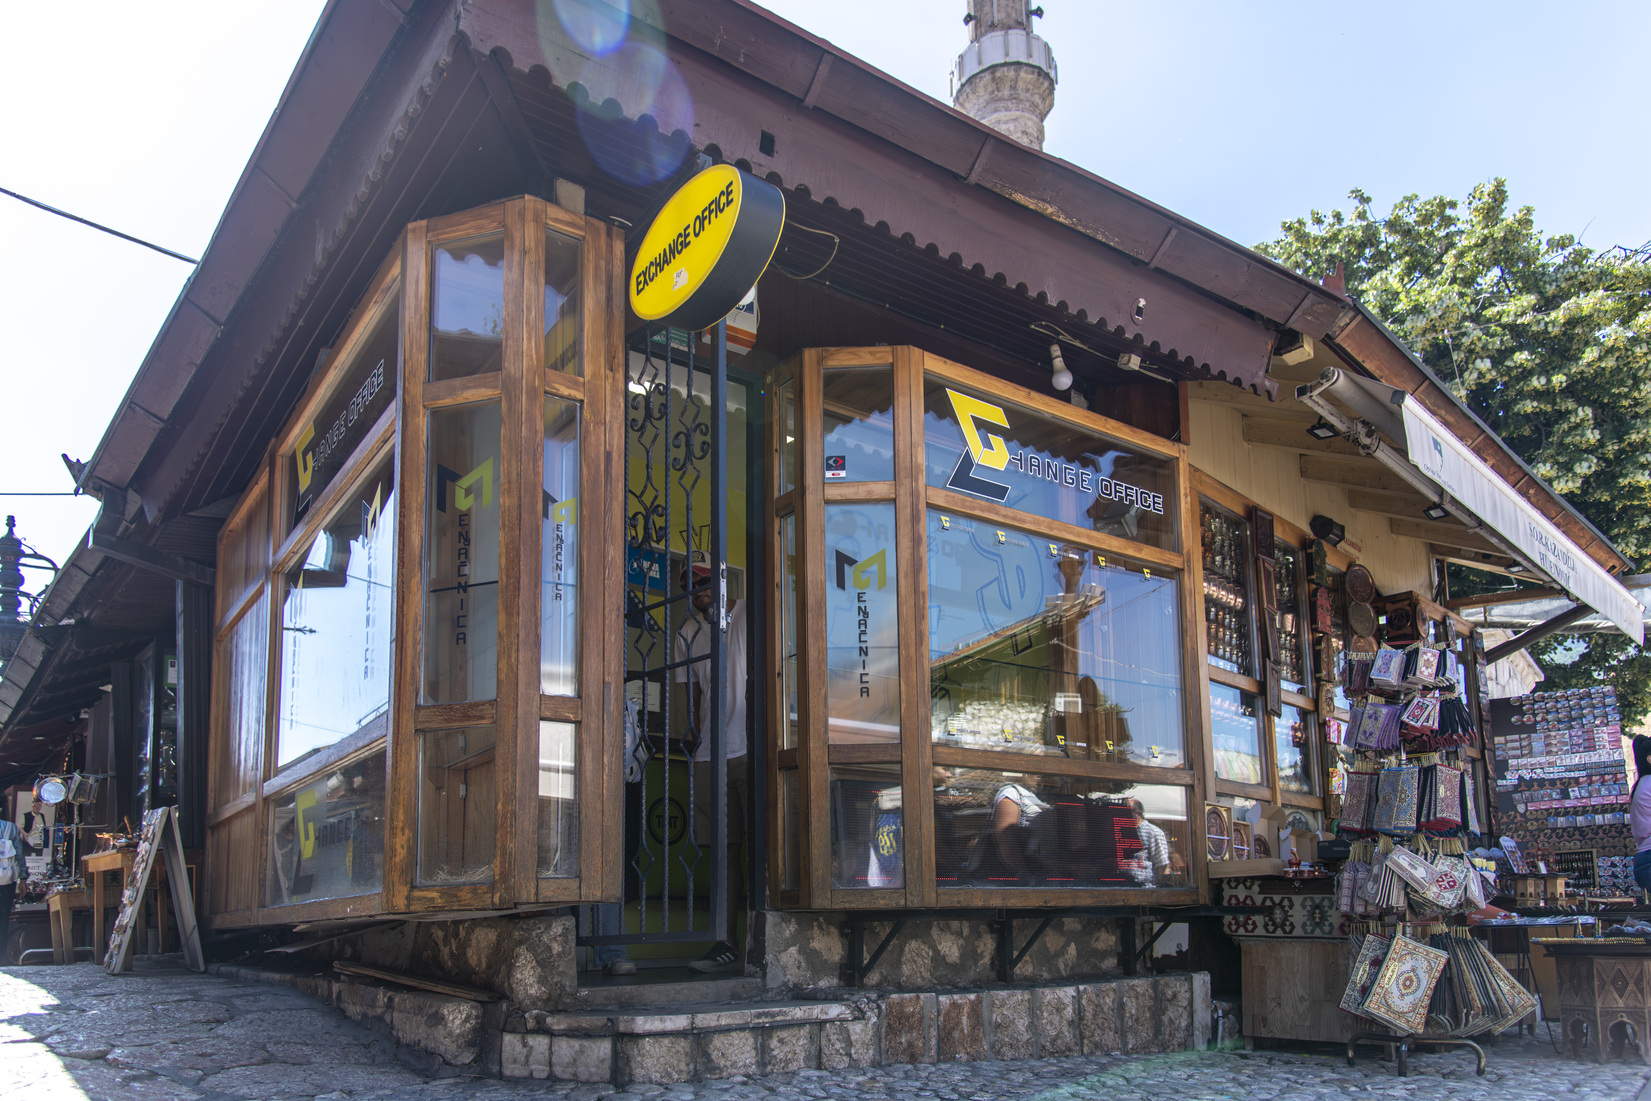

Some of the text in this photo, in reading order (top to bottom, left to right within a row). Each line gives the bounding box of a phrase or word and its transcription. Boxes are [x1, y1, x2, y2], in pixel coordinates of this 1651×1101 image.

[635, 180, 734, 296] EXCHANGE OFFICE
[348, 358, 384, 427] OFFICE
[1098, 476, 1164, 515] OFFICE
